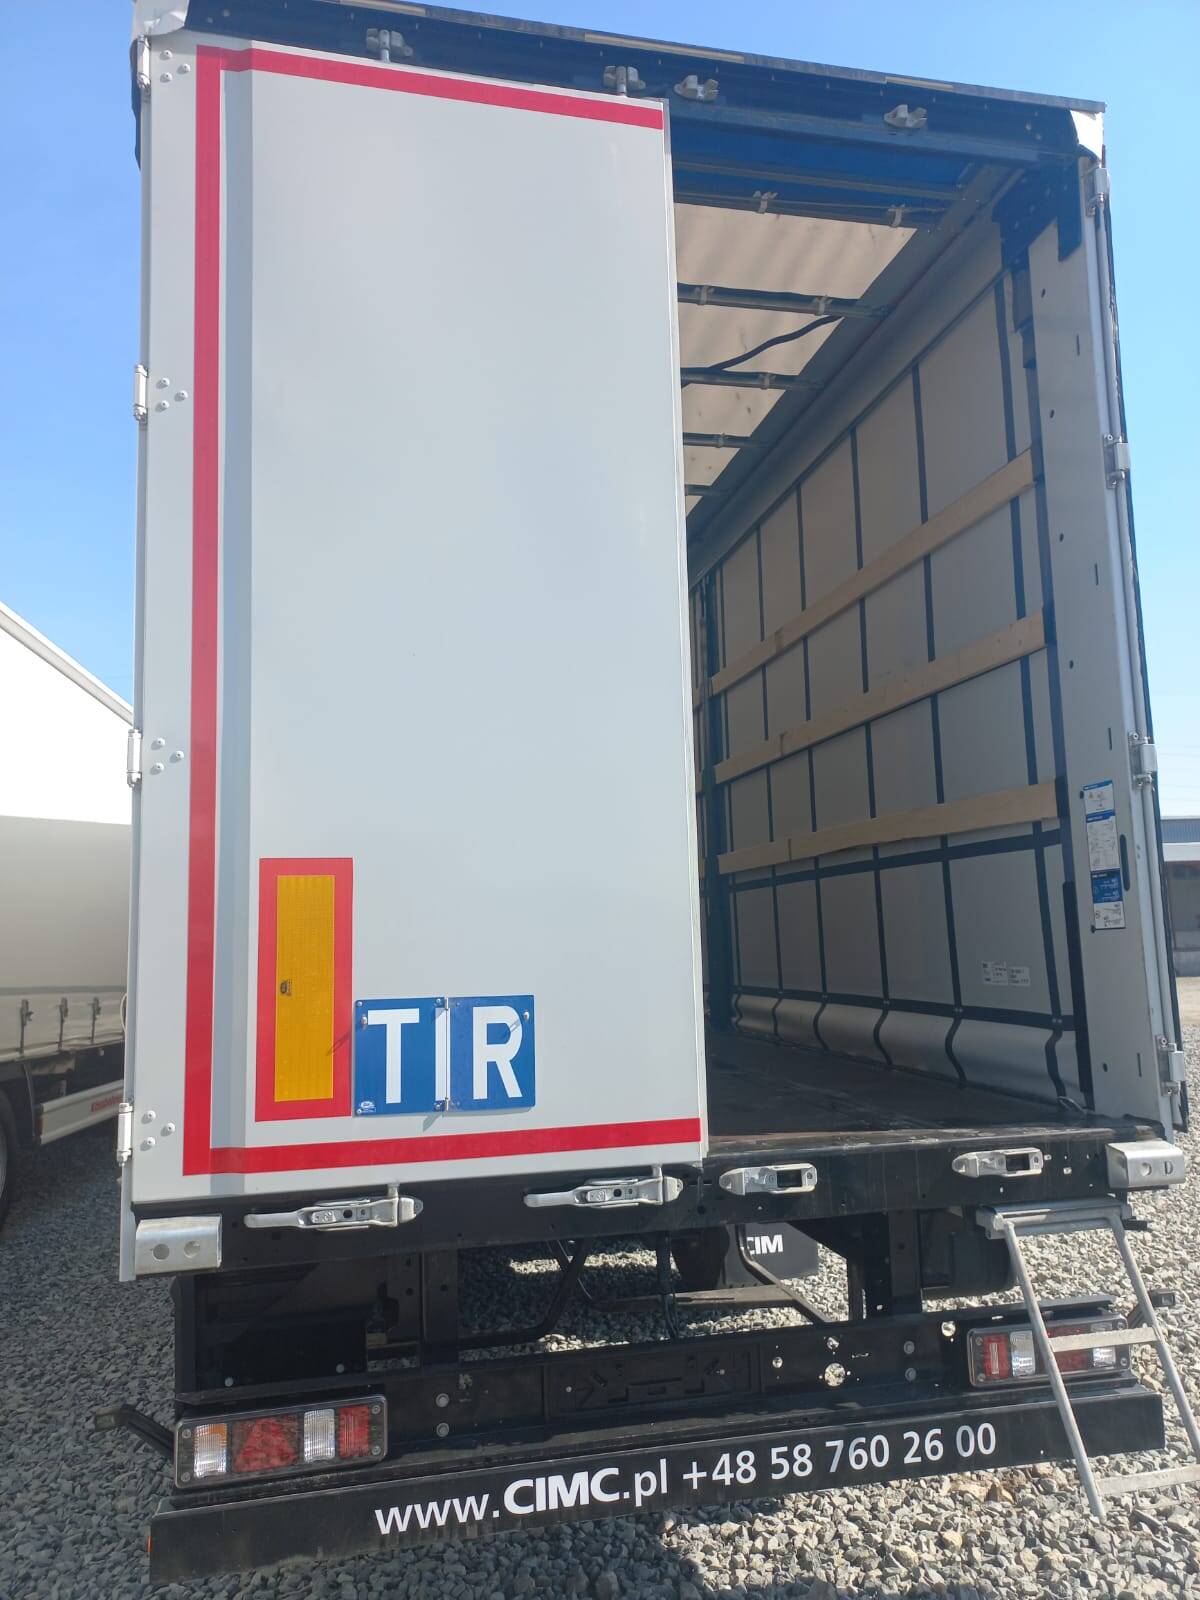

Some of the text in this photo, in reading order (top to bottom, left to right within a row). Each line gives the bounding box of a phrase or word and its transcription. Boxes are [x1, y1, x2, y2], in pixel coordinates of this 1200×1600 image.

[368, 1006, 523, 1104] TIR
[374, 1422, 997, 1535] www.CIMC.pl +48 58 760 26 00
